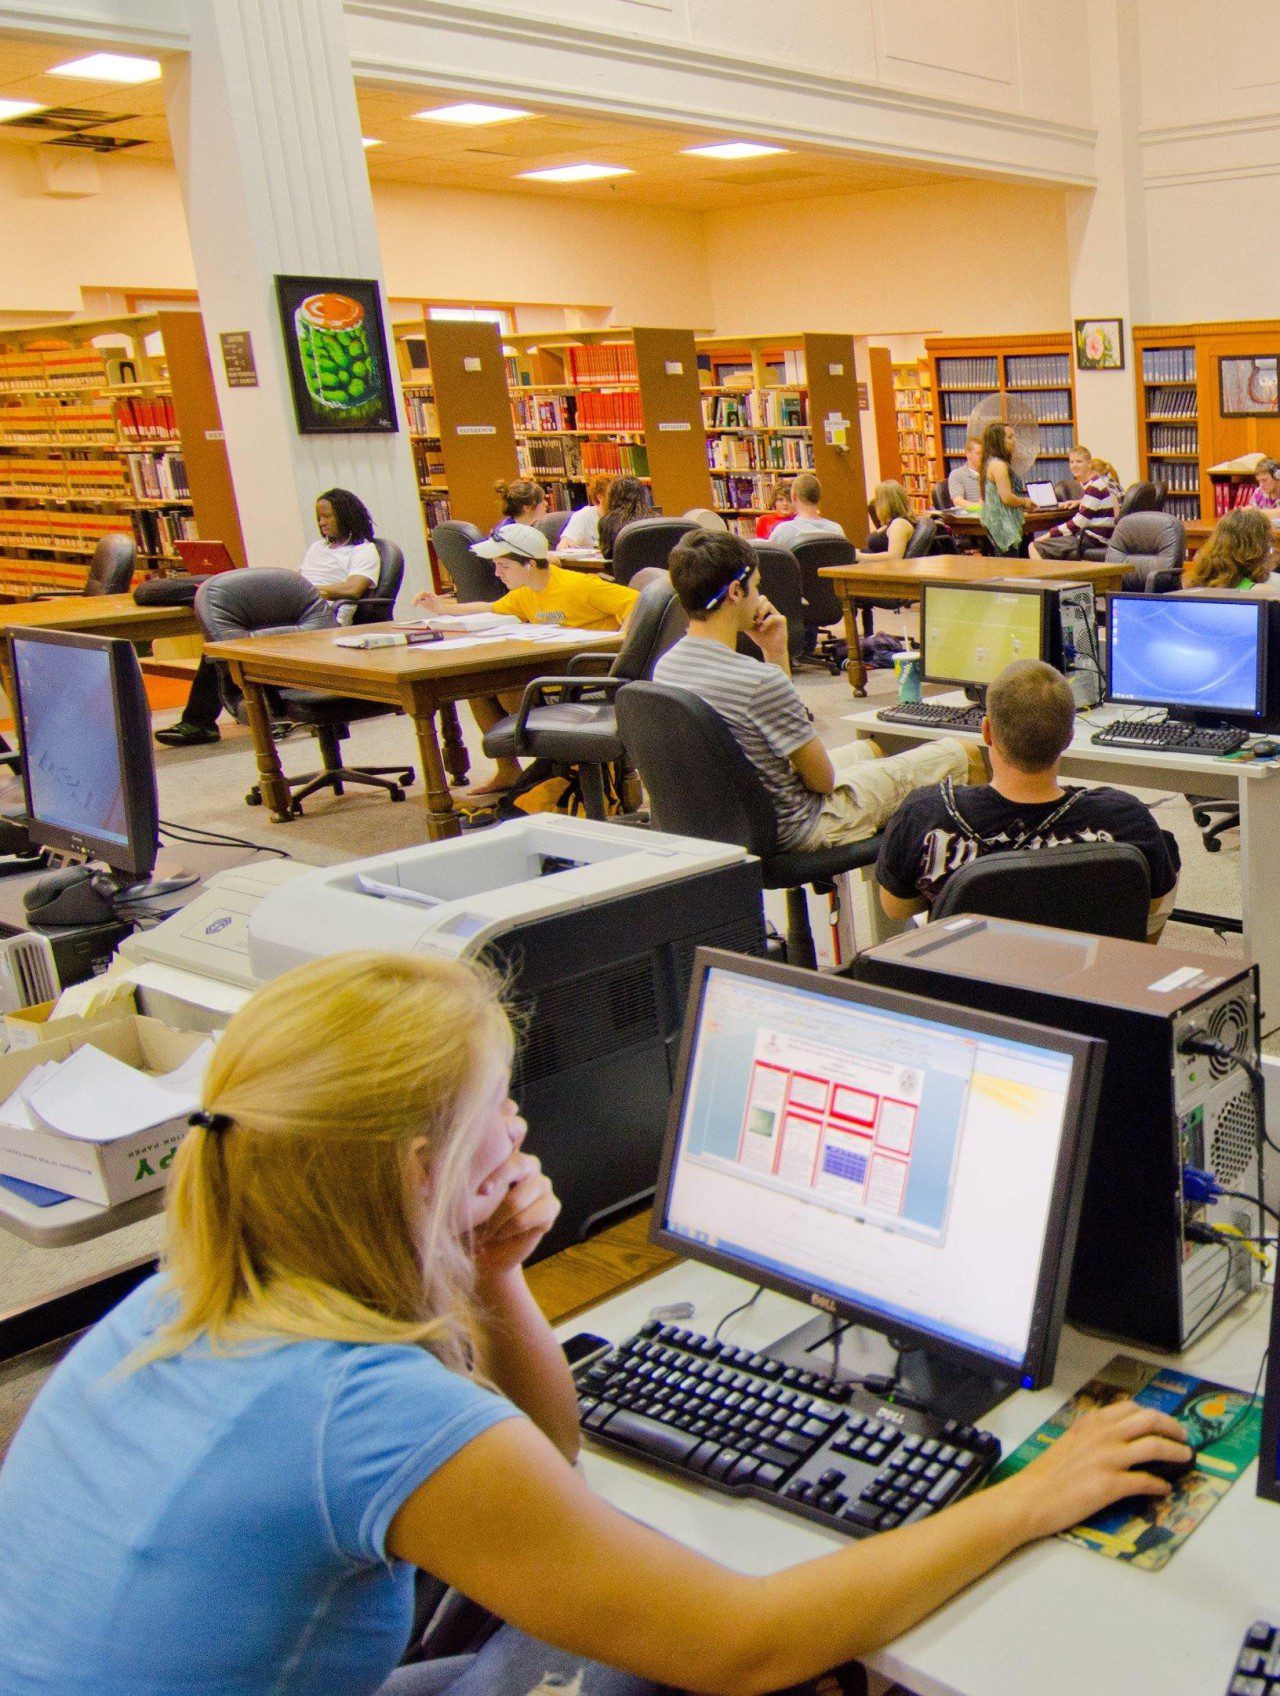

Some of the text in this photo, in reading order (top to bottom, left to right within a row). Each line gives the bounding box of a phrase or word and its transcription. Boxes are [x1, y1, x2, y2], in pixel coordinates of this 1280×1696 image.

[128, 1142, 160, 1158] PAPER
[134, 1146, 178, 1181] PY
[877, 1407, 905, 1424] DELL
